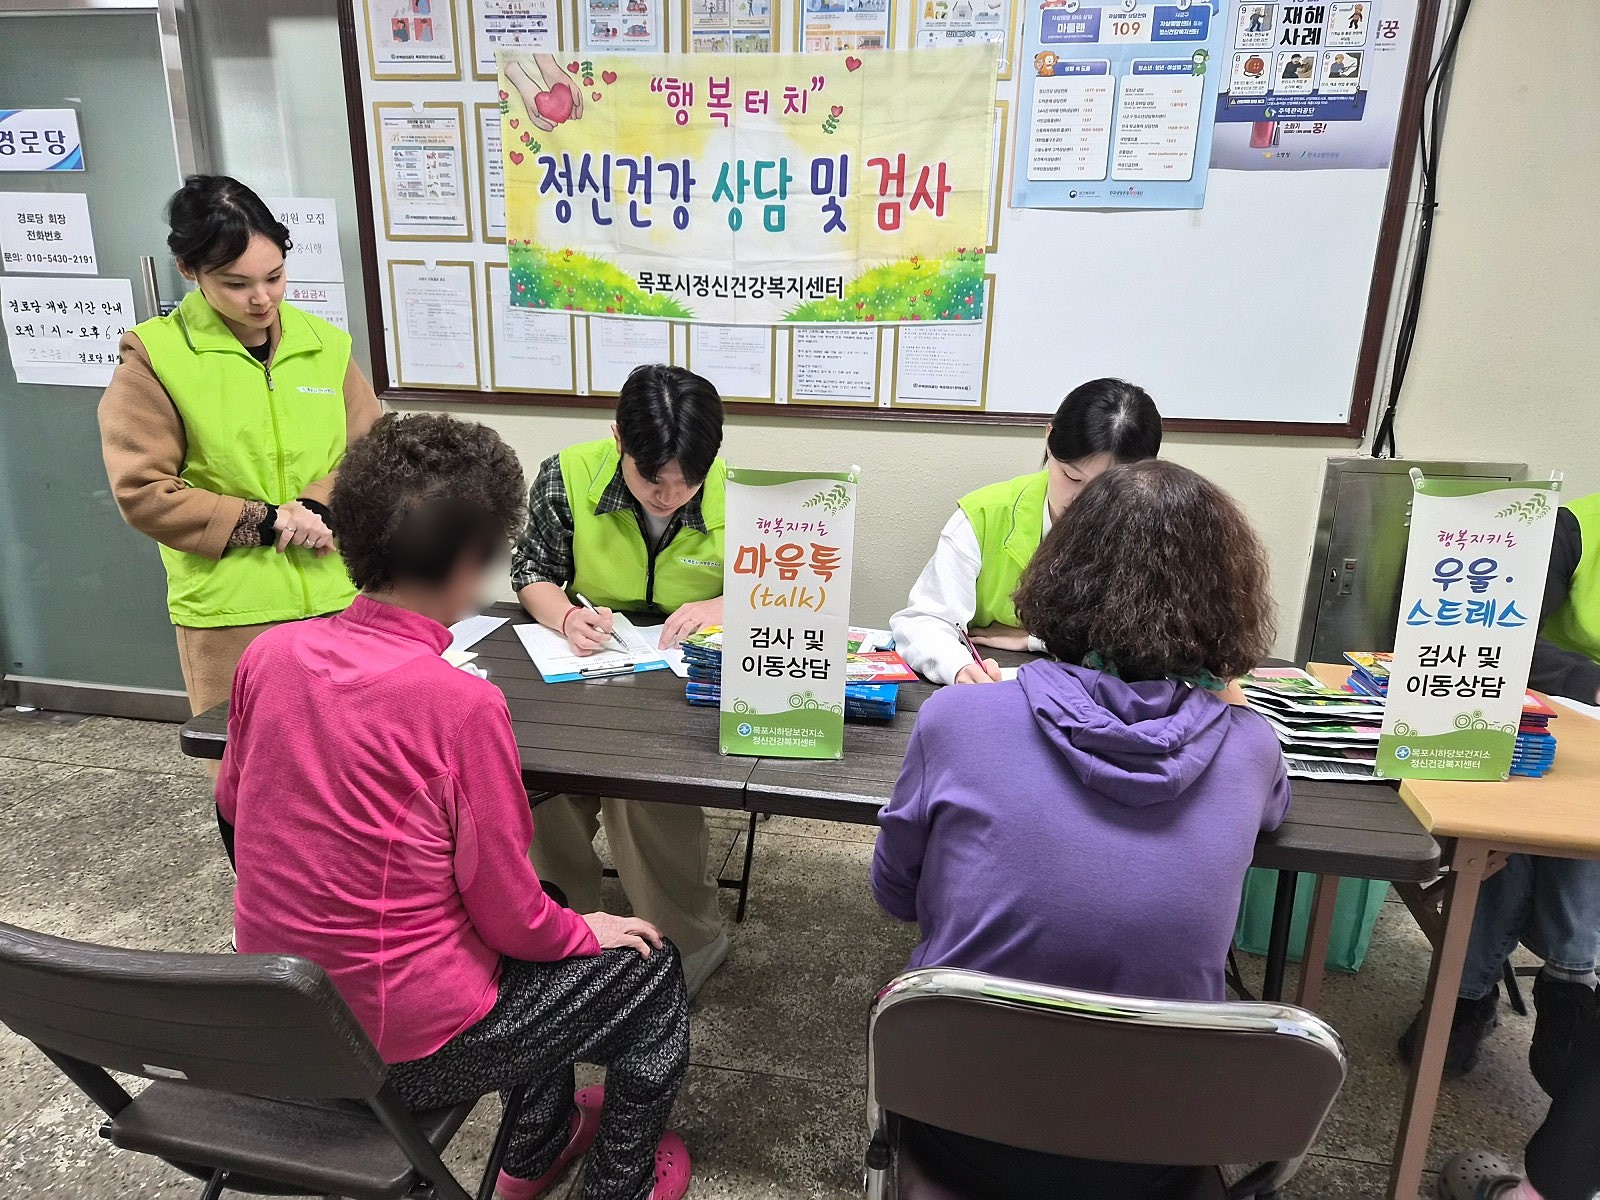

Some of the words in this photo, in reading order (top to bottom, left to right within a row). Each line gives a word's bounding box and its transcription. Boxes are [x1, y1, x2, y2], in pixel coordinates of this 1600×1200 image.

[1282, 5, 1326, 25] 재해
[1112, 21, 1141, 36] 109
[1279, 27, 1322, 46] 사례
[0, 130, 67, 156] 경로당
[537, 152, 697, 230] 정신건강
[711, 156, 794, 233] 상담
[810, 154, 848, 233] 및
[866, 153, 953, 231] 검사
[17, 212, 44, 224] 경로당
[48, 213, 67, 225] 회장
[280, 212, 300, 225] 회원
[306, 212, 325, 225] 모집
[27, 230, 63, 241] 전화번호
[4, 252, 23, 263] 문의:
[26, 253, 94, 264] 010-5430-2191
[292, 289, 327, 299] 출입금지
[636, 270, 844, 300] 목포시정신건강복지센터
[9, 300, 41, 314] 경로당
[46, 301, 68, 315] 개방
[73, 301, 96, 315] 시간
[101, 301, 123, 315] 안내
[14, 324, 36, 338] 오전
[51, 324, 62, 338] 시
[79, 326, 100, 339] 오후
[105, 325, 111, 340] 6
[79, 351, 103, 364] 경로당
[755, 516, 829, 538] 행복지키는
[1437, 529, 1517, 551] 행복지키는
[733, 542, 842, 583] 마음톡
[749, 583, 826, 613] (talk)
[1405, 597, 1528, 629] 스트레스
[749, 626, 794, 650] 검사
[804, 629, 825, 651] 및
[1418, 644, 1467, 668] 검사
[1477, 645, 1501, 668] 및
[741, 654, 831, 680] 이동상담
[1406, 674, 1506, 699] 이동상담
[752, 725, 825, 738] 목포시하당보건지소
[752, 736, 817, 748] 정신건강복지센터
[1411, 748, 1491, 760] 목포시하당보건지소
[1410, 758, 1481, 770] 정신건강복지센터
